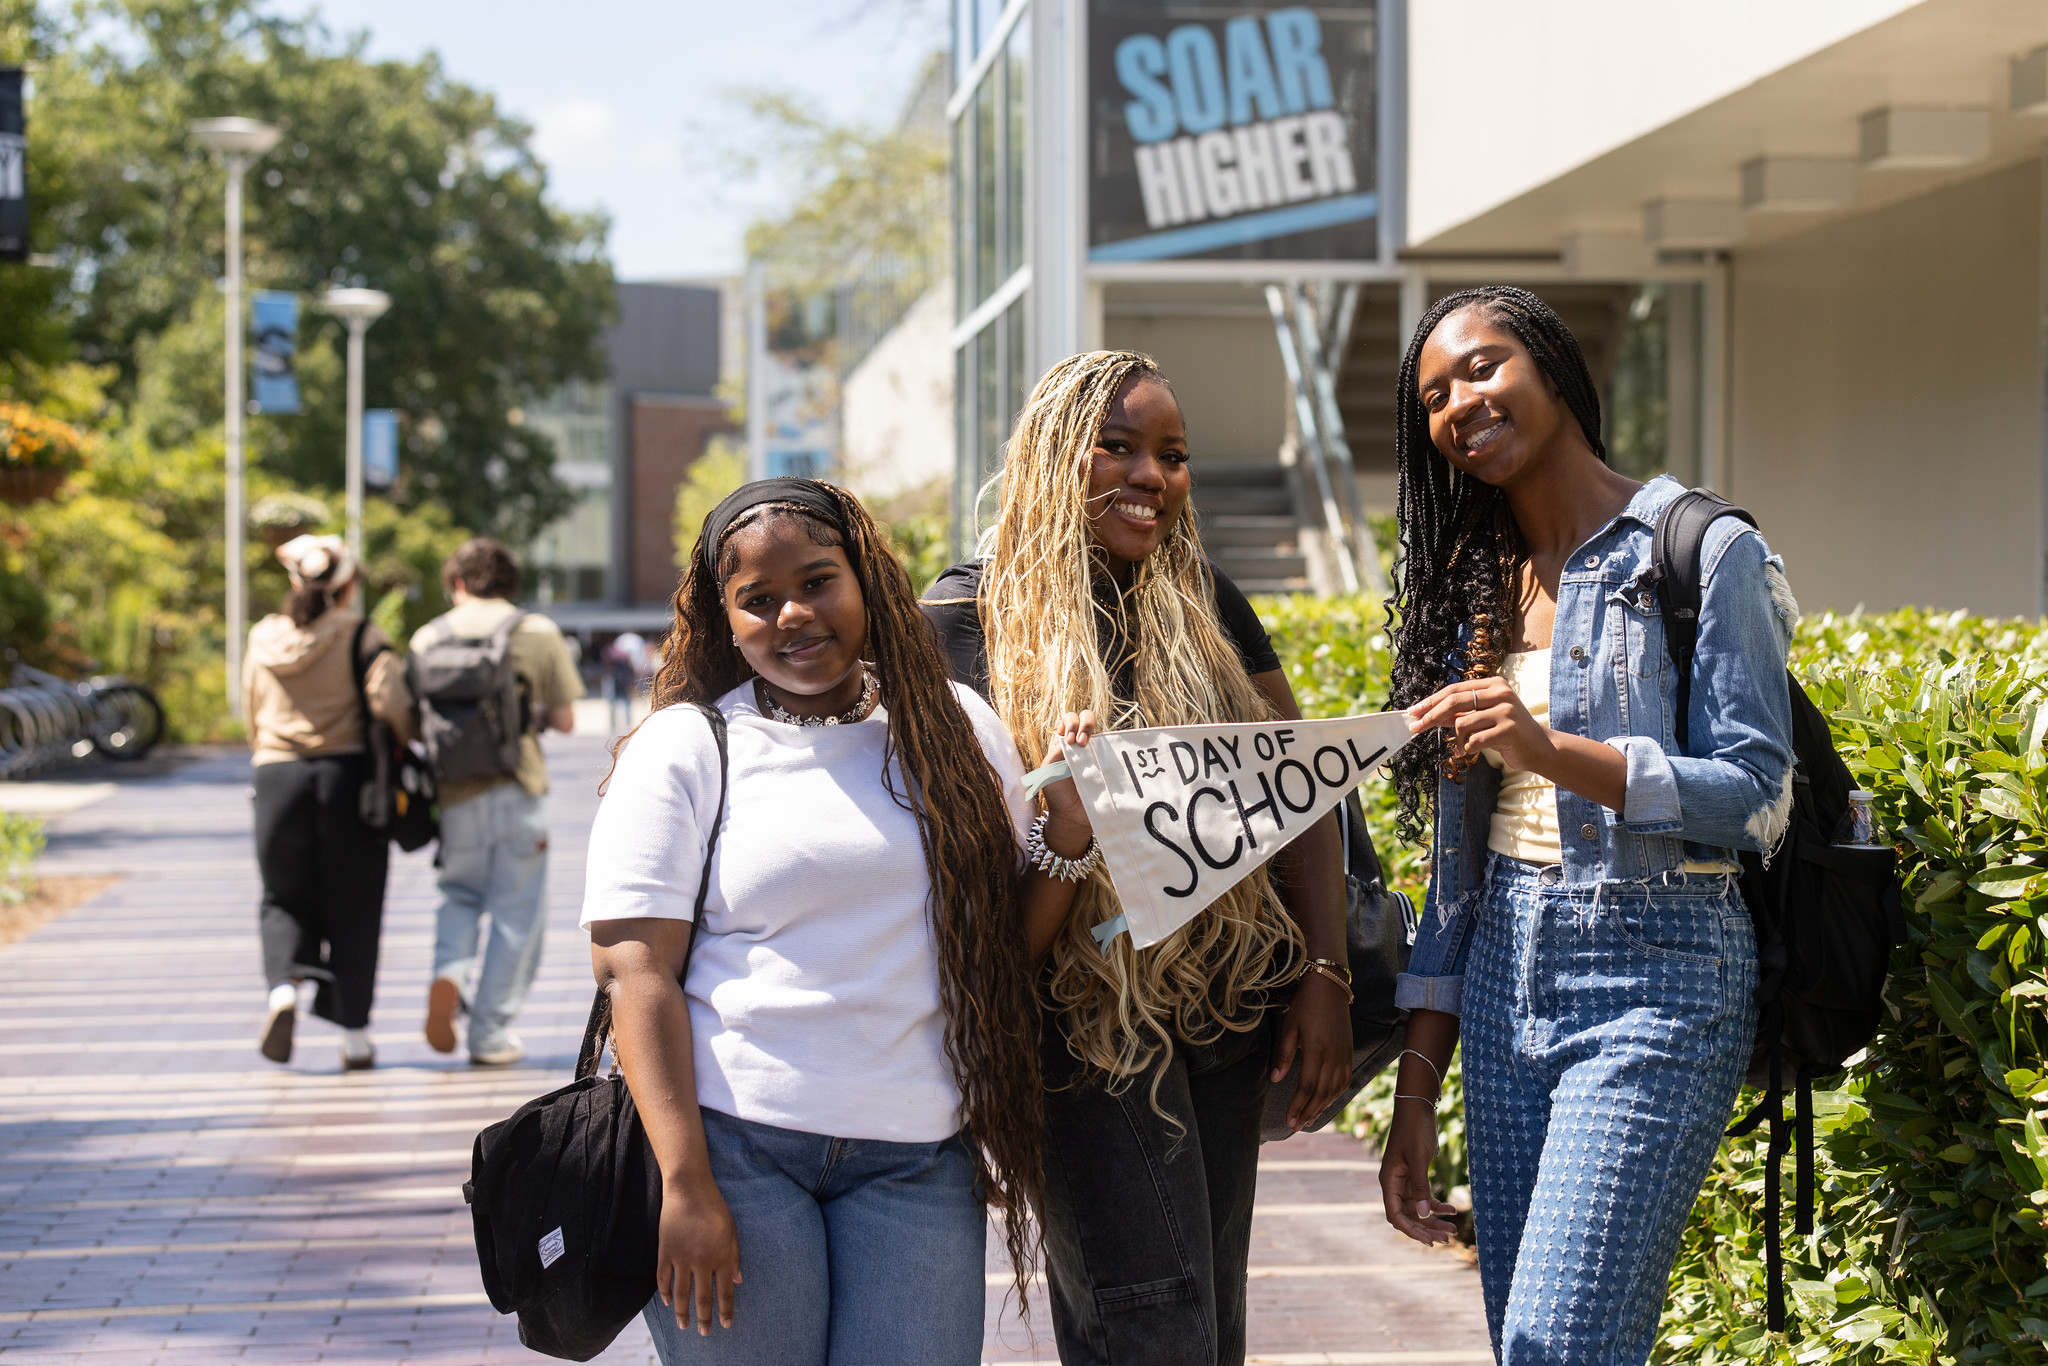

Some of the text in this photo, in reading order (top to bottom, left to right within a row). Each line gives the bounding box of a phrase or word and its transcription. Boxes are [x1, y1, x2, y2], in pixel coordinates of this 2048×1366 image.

[1114, 6, 1335, 146] SOAR
[1133, 109, 1357, 230] HIGHER
[1121, 728, 1296, 799] 1ST DAY OF
[1143, 738, 1388, 898] SCHOOL
